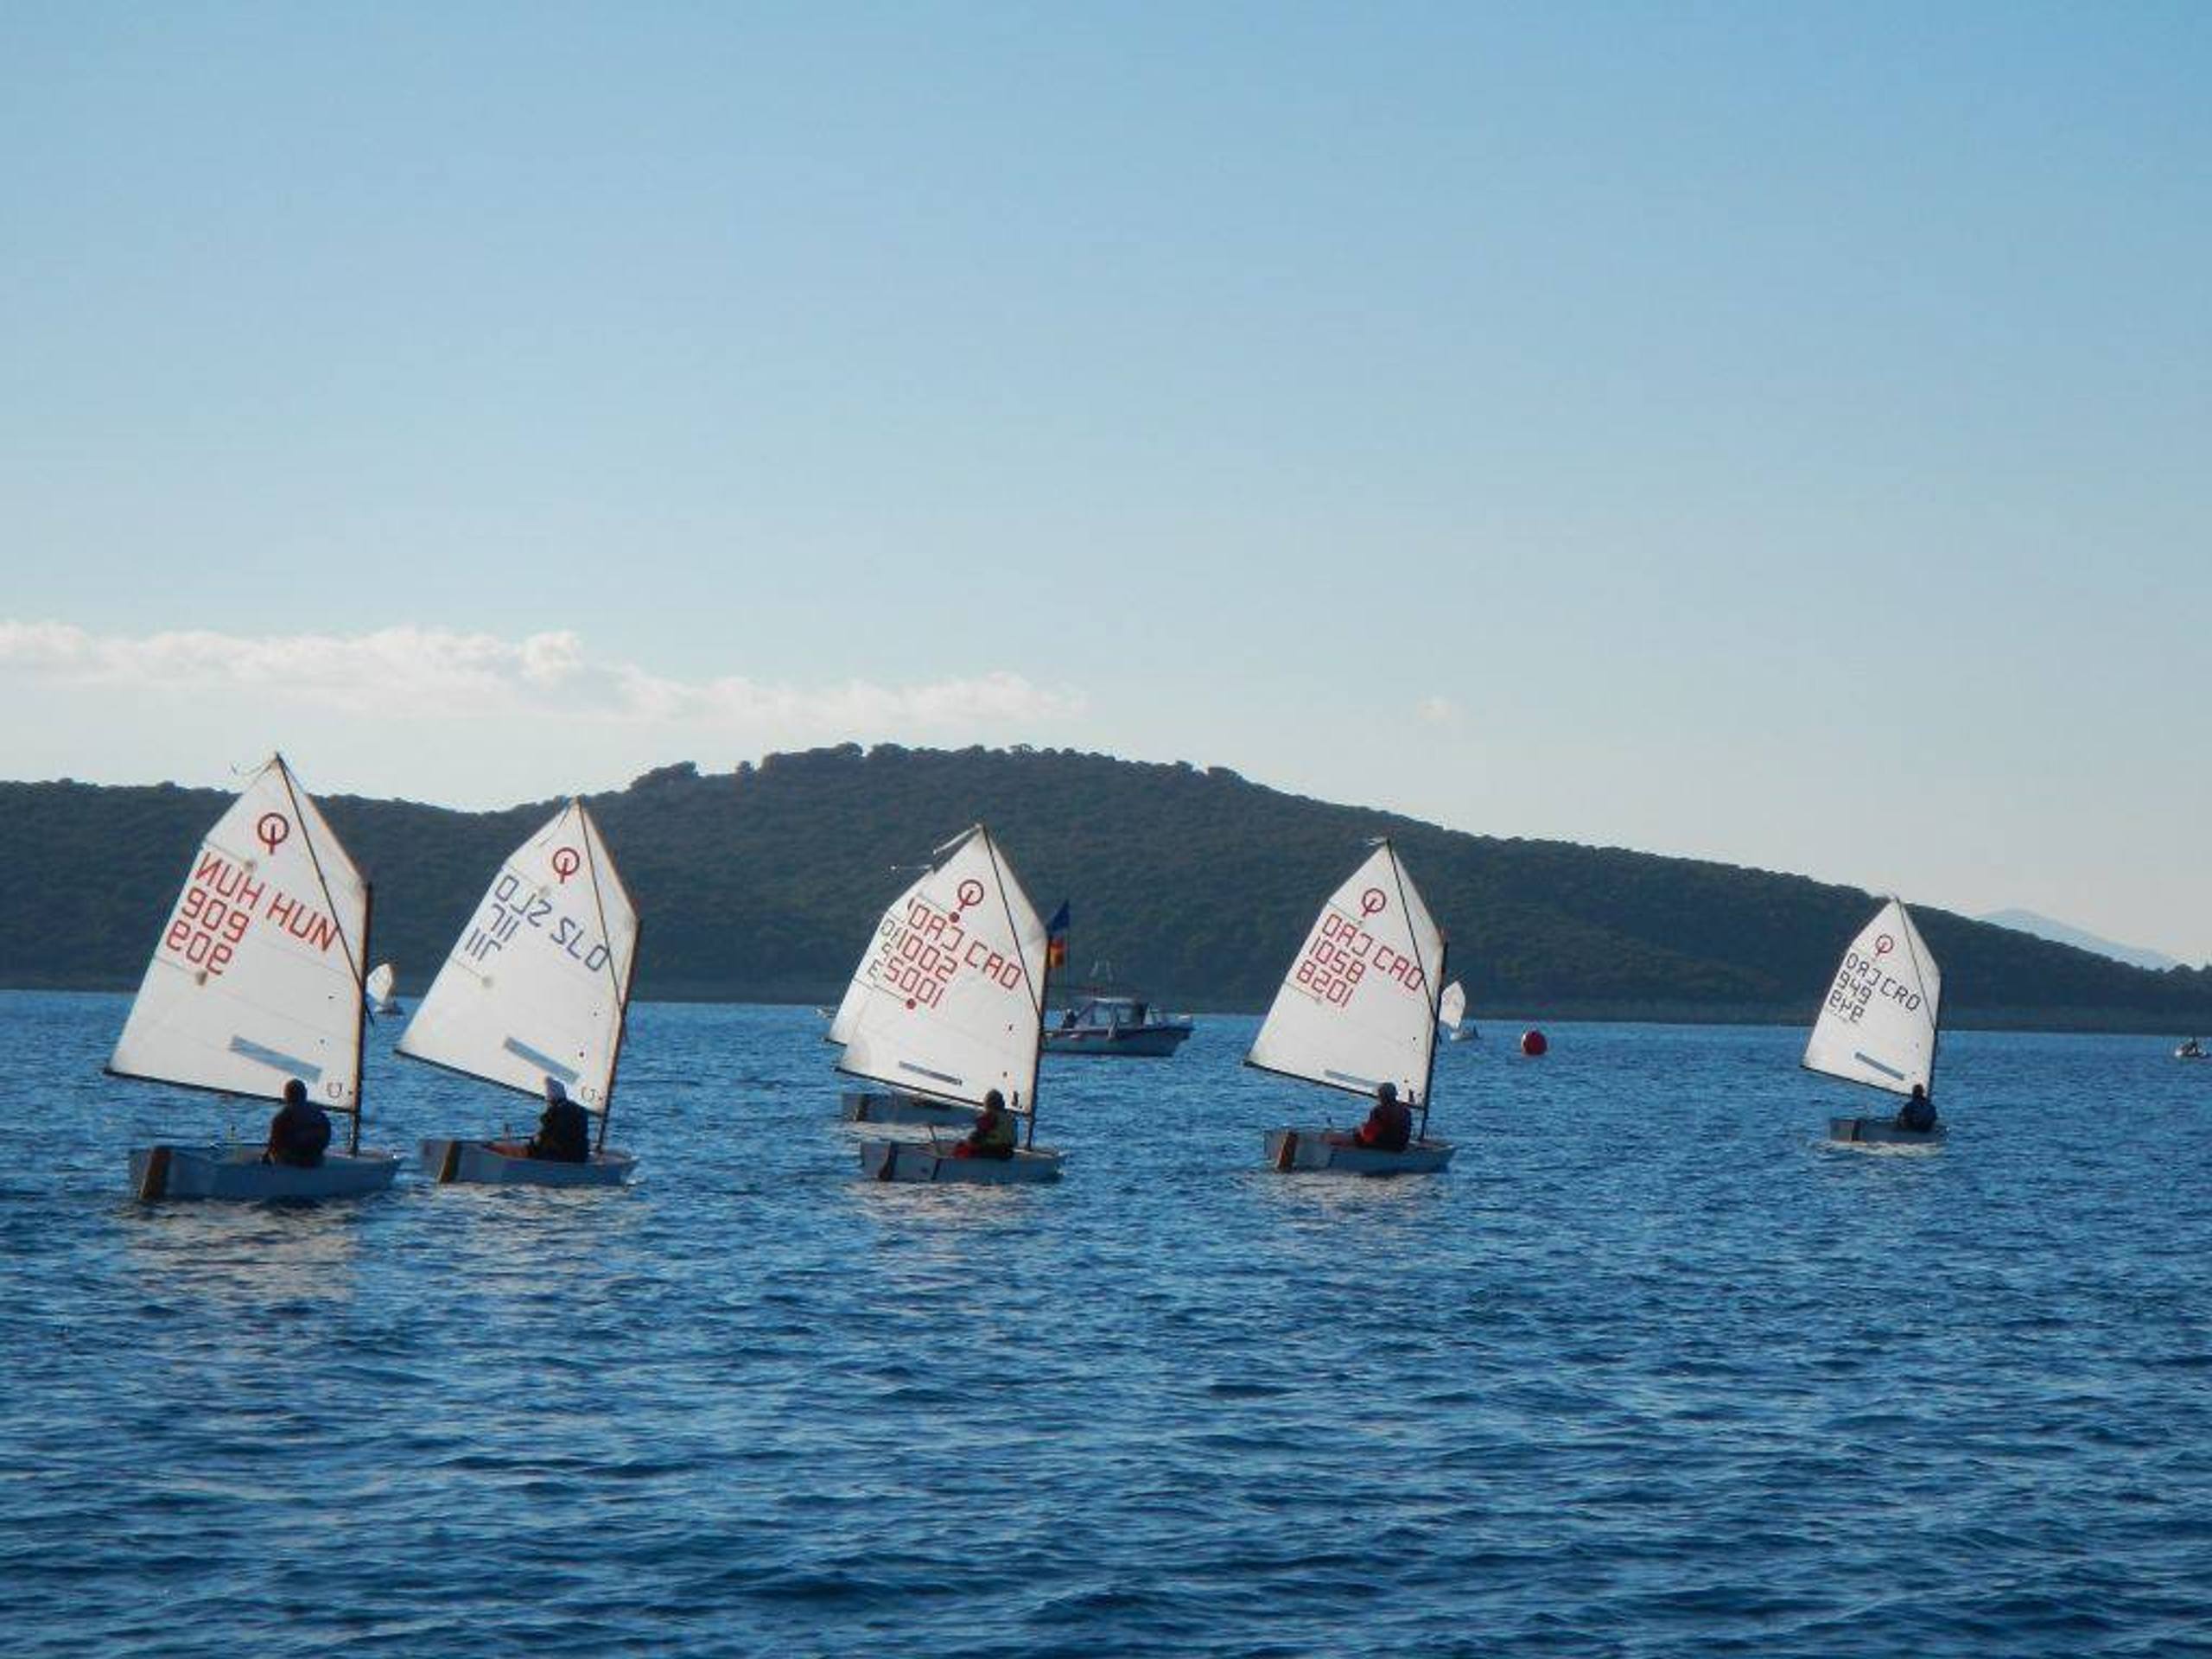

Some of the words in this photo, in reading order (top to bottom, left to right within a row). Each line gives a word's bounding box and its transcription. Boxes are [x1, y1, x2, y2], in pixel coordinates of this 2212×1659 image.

[181, 887, 250, 944] 909
[266, 893, 339, 951] HUN
[550, 917, 609, 971] SLO
[896, 929, 957, 983] 1002
[1309, 936, 1366, 984] 1058
[1880, 978, 1921, 1011] CRO
